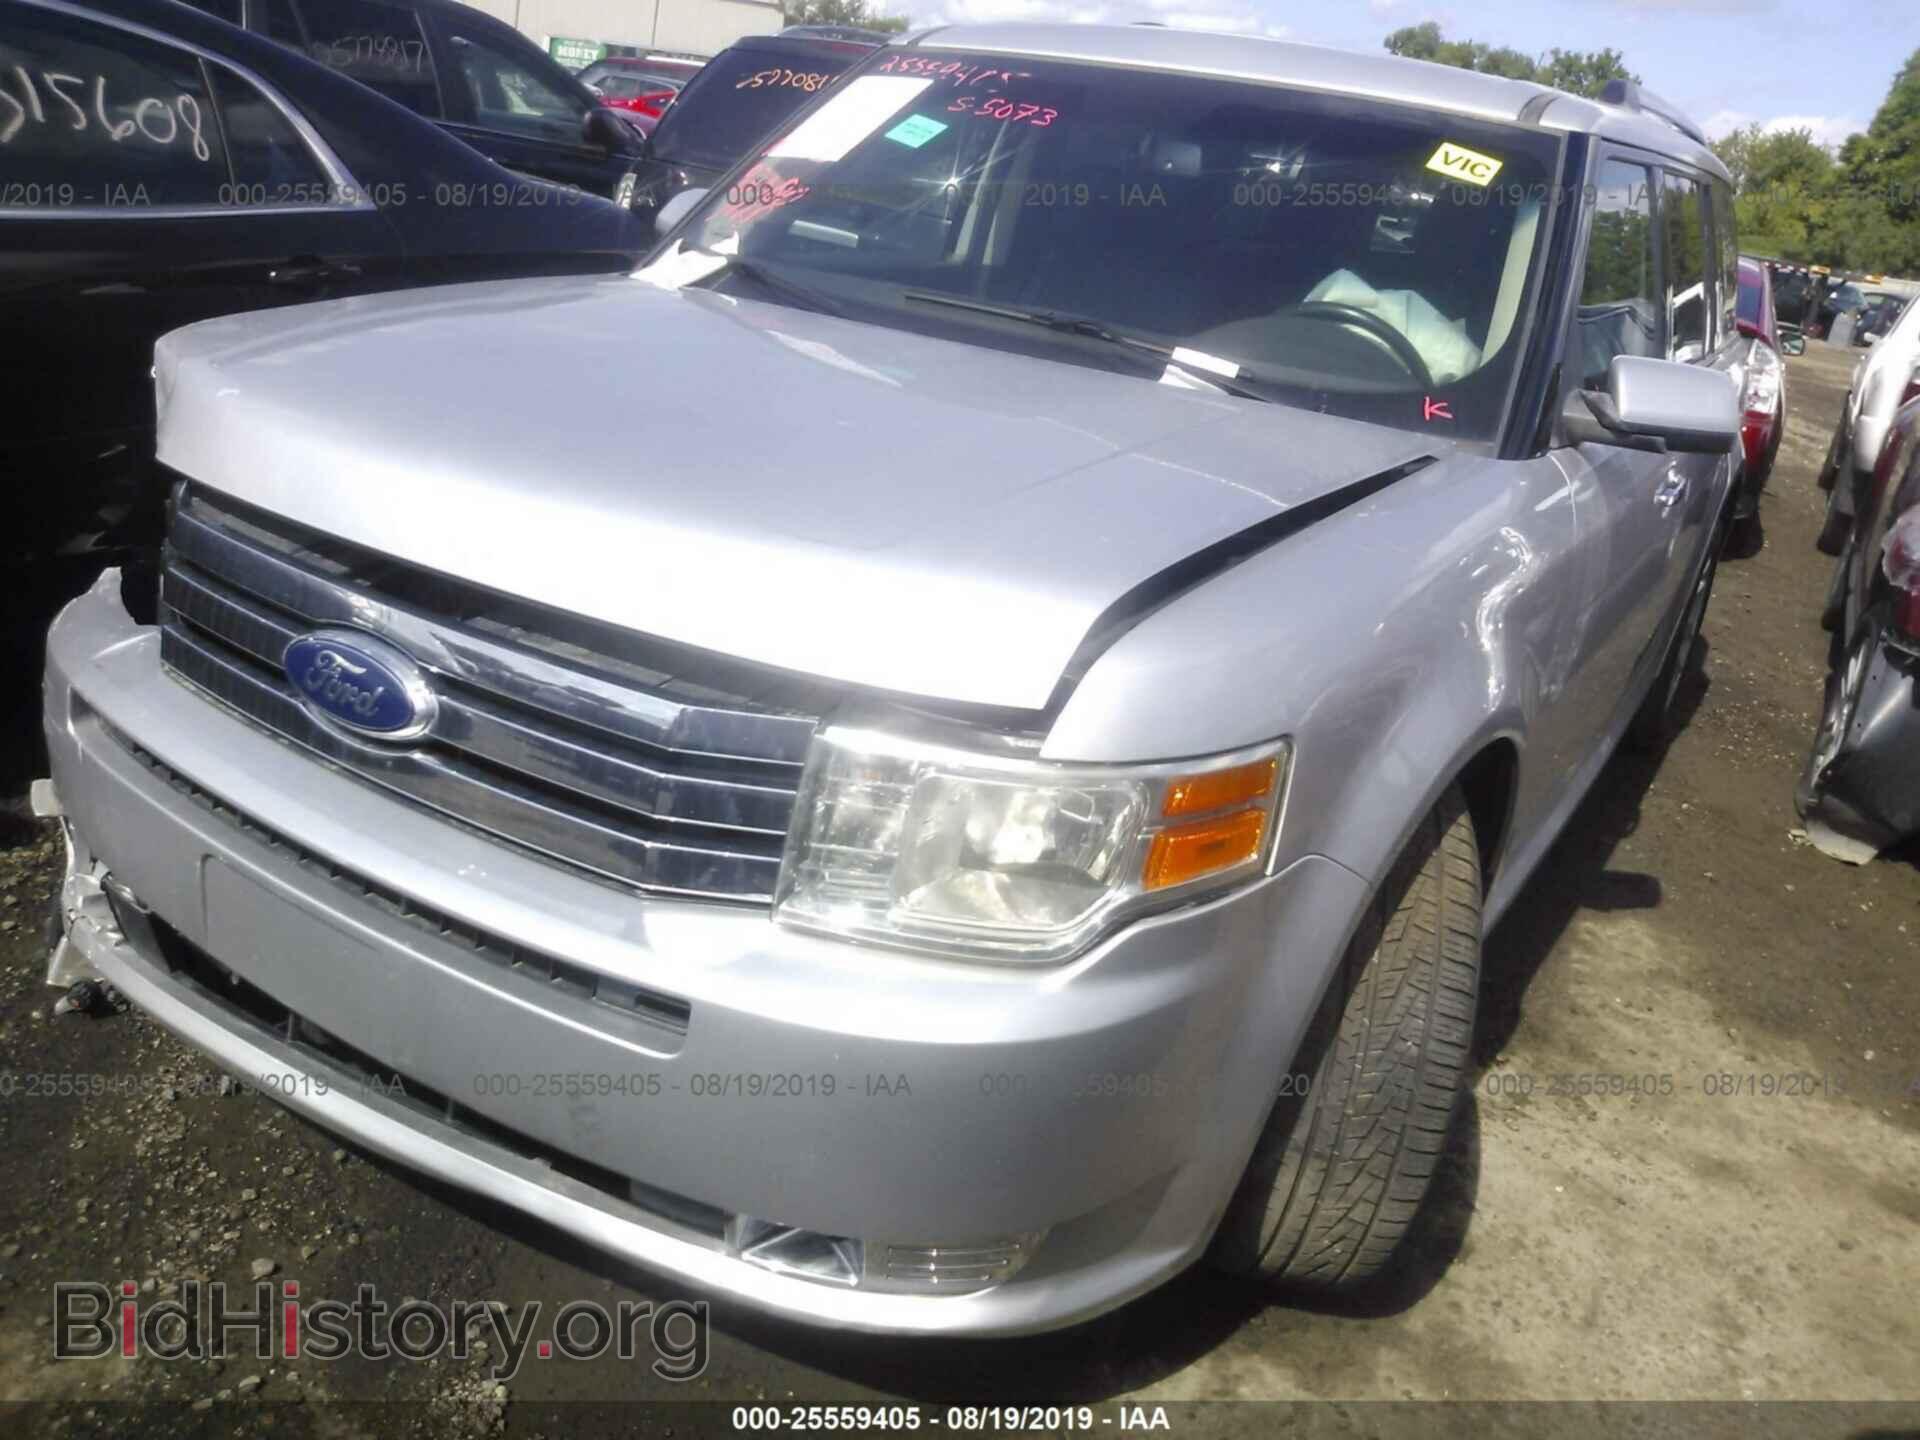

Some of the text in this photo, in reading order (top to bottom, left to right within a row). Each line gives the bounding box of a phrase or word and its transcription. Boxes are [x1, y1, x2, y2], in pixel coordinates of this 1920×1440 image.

[1443, 151, 1492, 178] VIC
[1424, 396, 1453, 420] K
[305, 650, 386, 716] Ford
